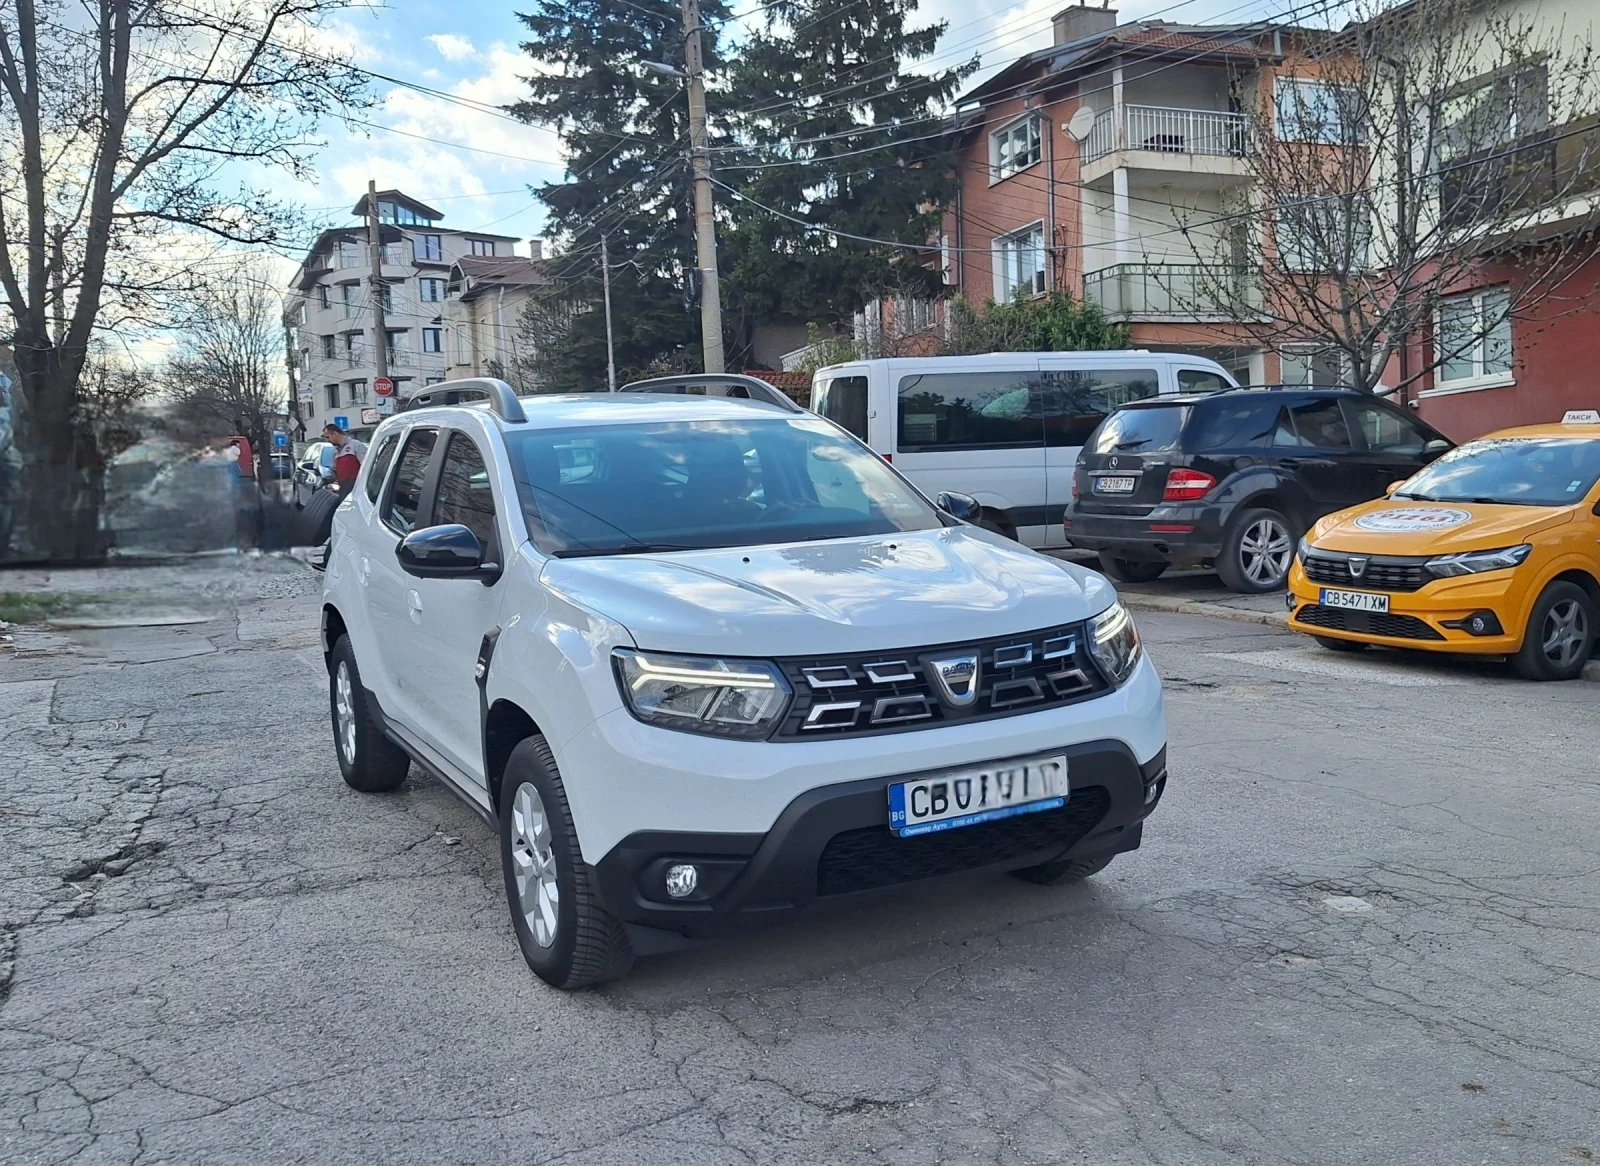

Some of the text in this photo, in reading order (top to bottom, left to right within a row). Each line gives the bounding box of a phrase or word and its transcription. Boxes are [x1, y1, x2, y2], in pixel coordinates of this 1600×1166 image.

[375, 383, 391, 391] STOP
[1326, 591, 1386, 610] CB 5471 XM
[892, 810, 905, 821] BG
[933, 823, 947, 831] Ауто
